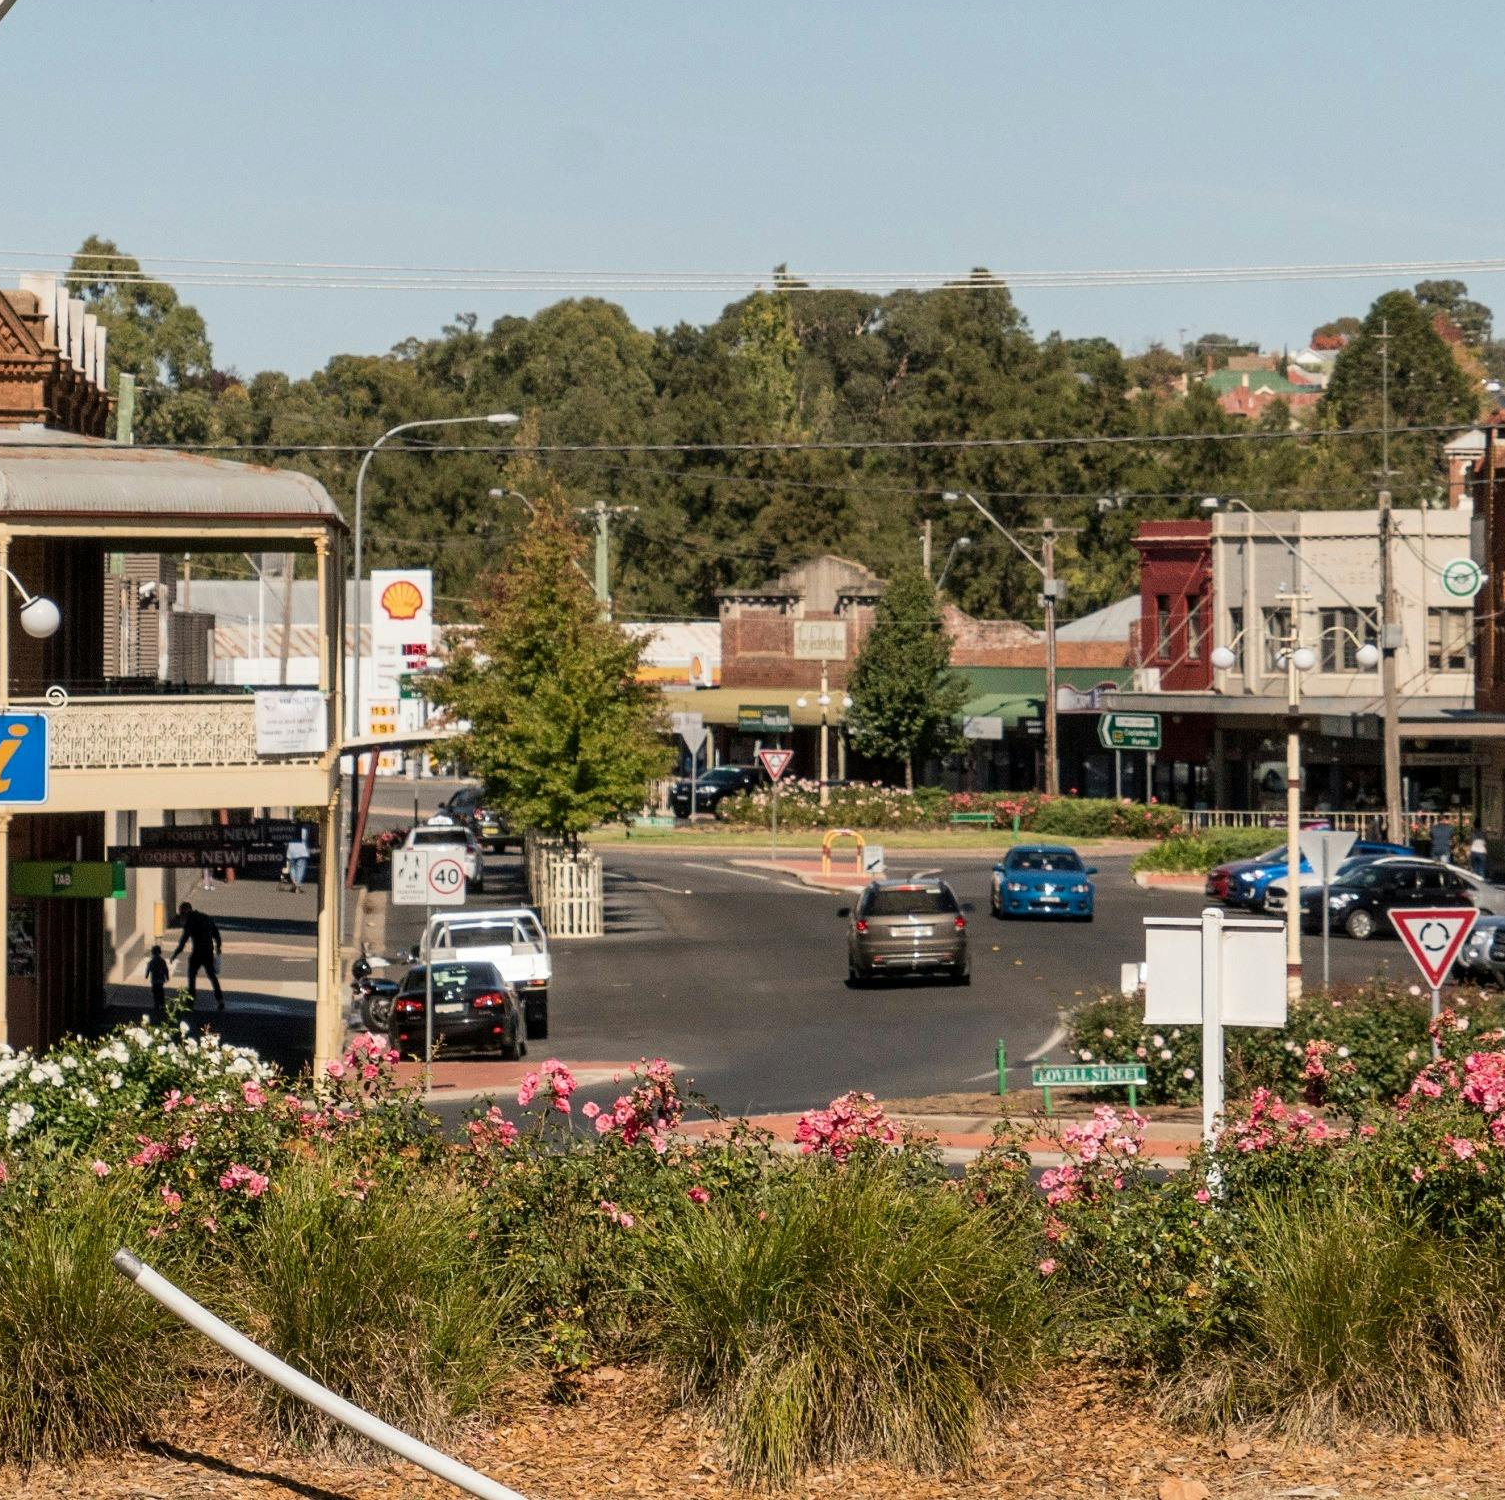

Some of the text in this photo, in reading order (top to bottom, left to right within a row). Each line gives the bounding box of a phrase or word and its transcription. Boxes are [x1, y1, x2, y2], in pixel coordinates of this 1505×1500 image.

[201, 850, 240, 864] NEW
[54, 873, 71, 885] TAB
[434, 868, 459, 885] 40
[1039, 1066, 1141, 1082] LOVELL STREET
